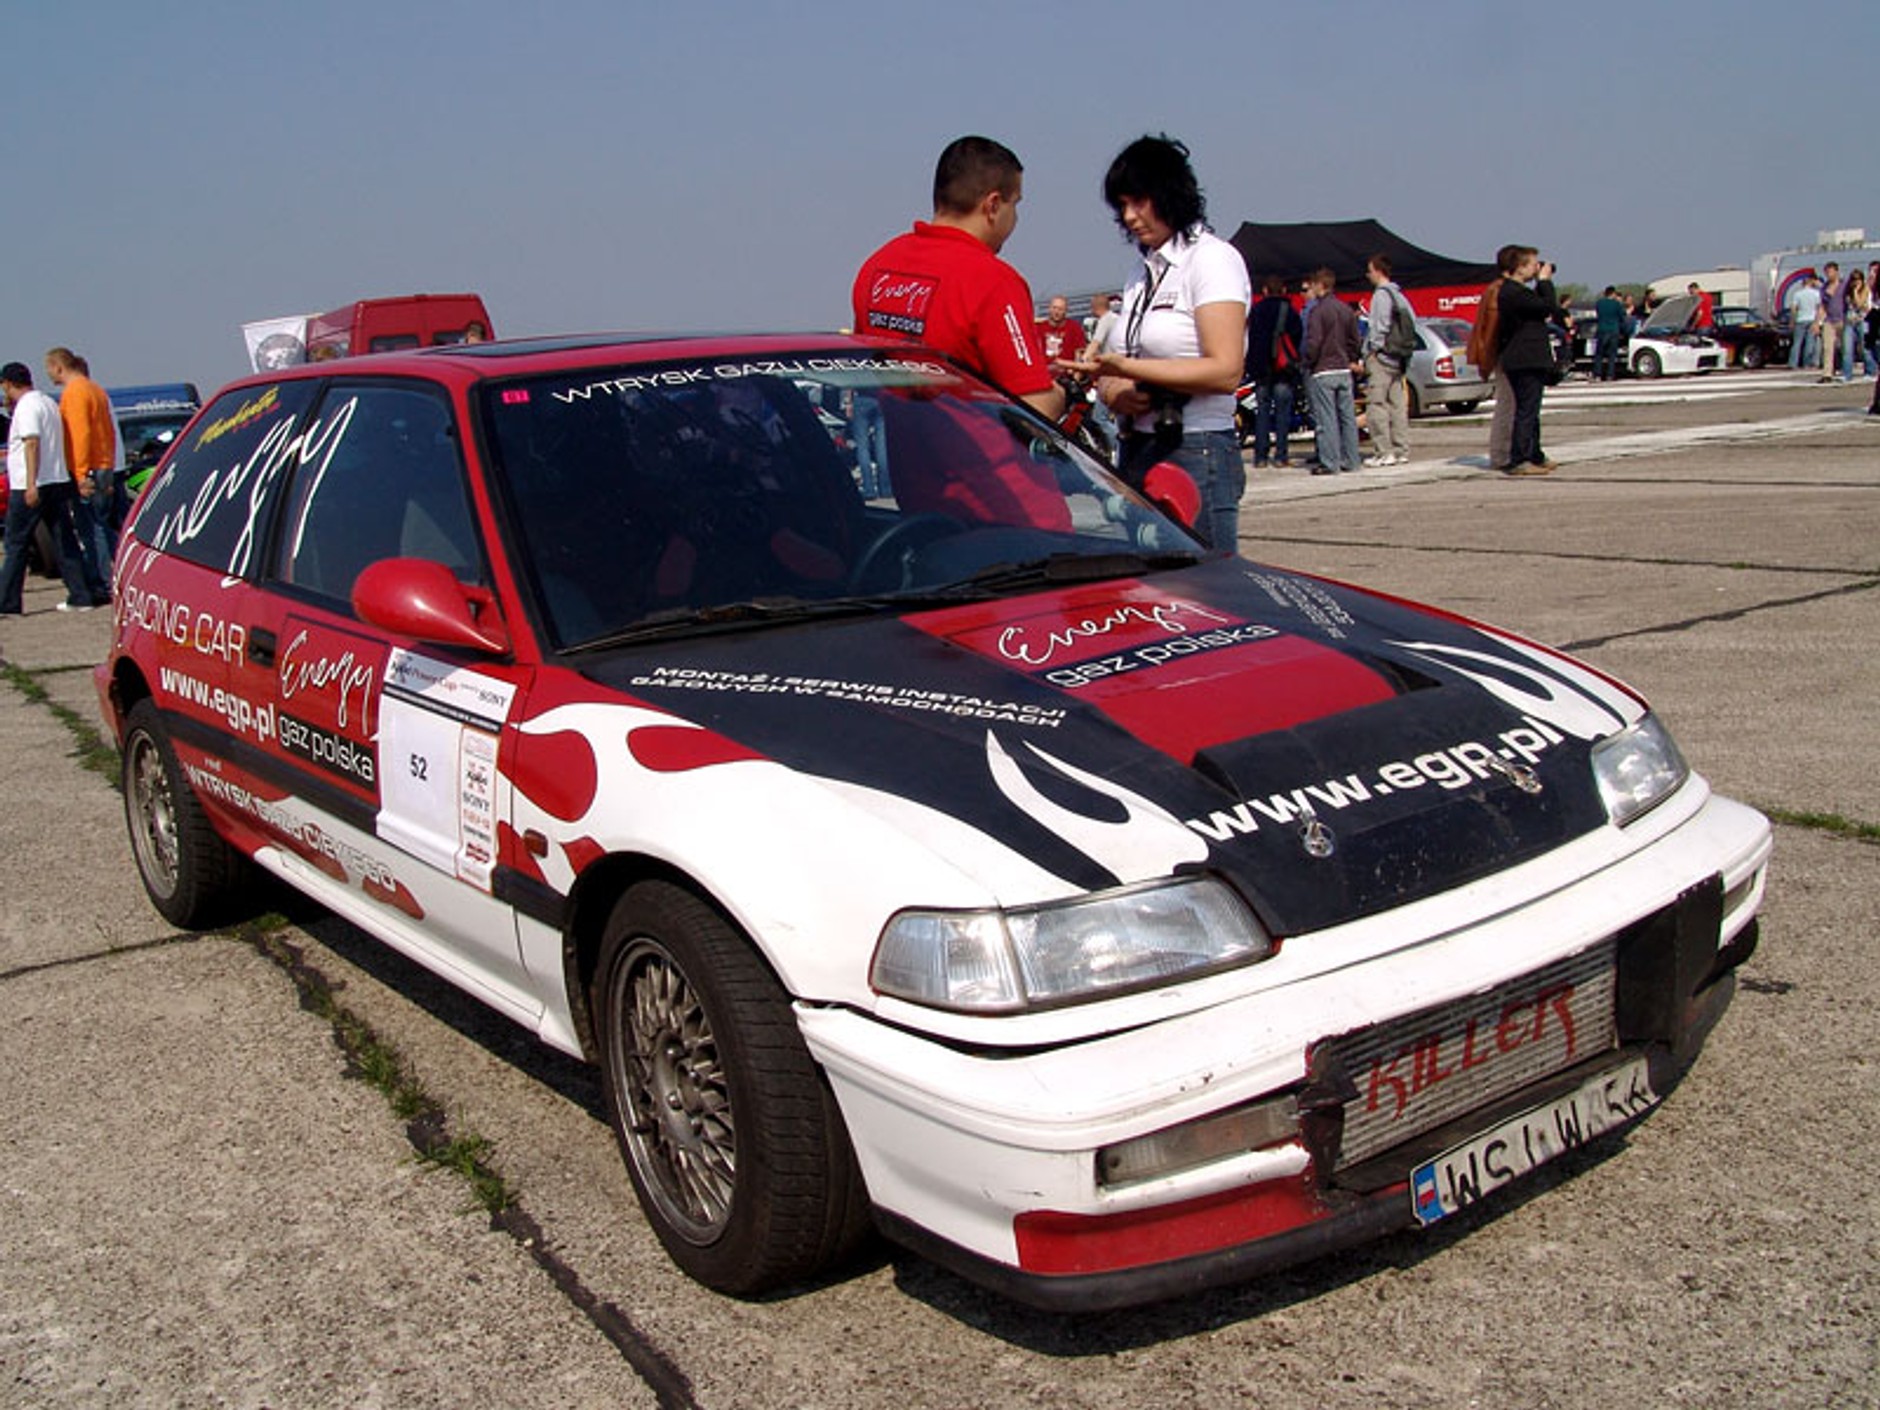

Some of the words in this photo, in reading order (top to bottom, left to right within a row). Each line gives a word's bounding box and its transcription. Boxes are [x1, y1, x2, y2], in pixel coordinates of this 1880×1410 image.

[872, 273, 932, 314] Energy
[552, 367, 712, 403] WTRYSK
[714, 361, 805, 378] GAZU
[124, 585, 190, 645] RACING
[195, 612, 247, 668] CAR
[997, 599, 1229, 665] Energy
[1045, 655, 1139, 688] gaz
[1134, 624, 1280, 666] polska
[160, 666, 276, 742] www.egp.pl
[281, 629, 374, 735] Energy
[631, 676, 789, 693] GAZOWYCH
[794, 686, 822, 696] W
[825, 690, 1061, 728] SAMOCHODACH
[652, 667, 770, 683] MONTAŻ
[784, 676, 894, 695] SERWIS
[900, 688, 1067, 718] INSTALACJI
[279, 715, 309, 747] gaz
[311, 731, 375, 782] polska
[409, 753, 429, 782] 52
[1184, 714, 1564, 843] www.egp.pl
[1363, 980, 1577, 1121] KILLER
